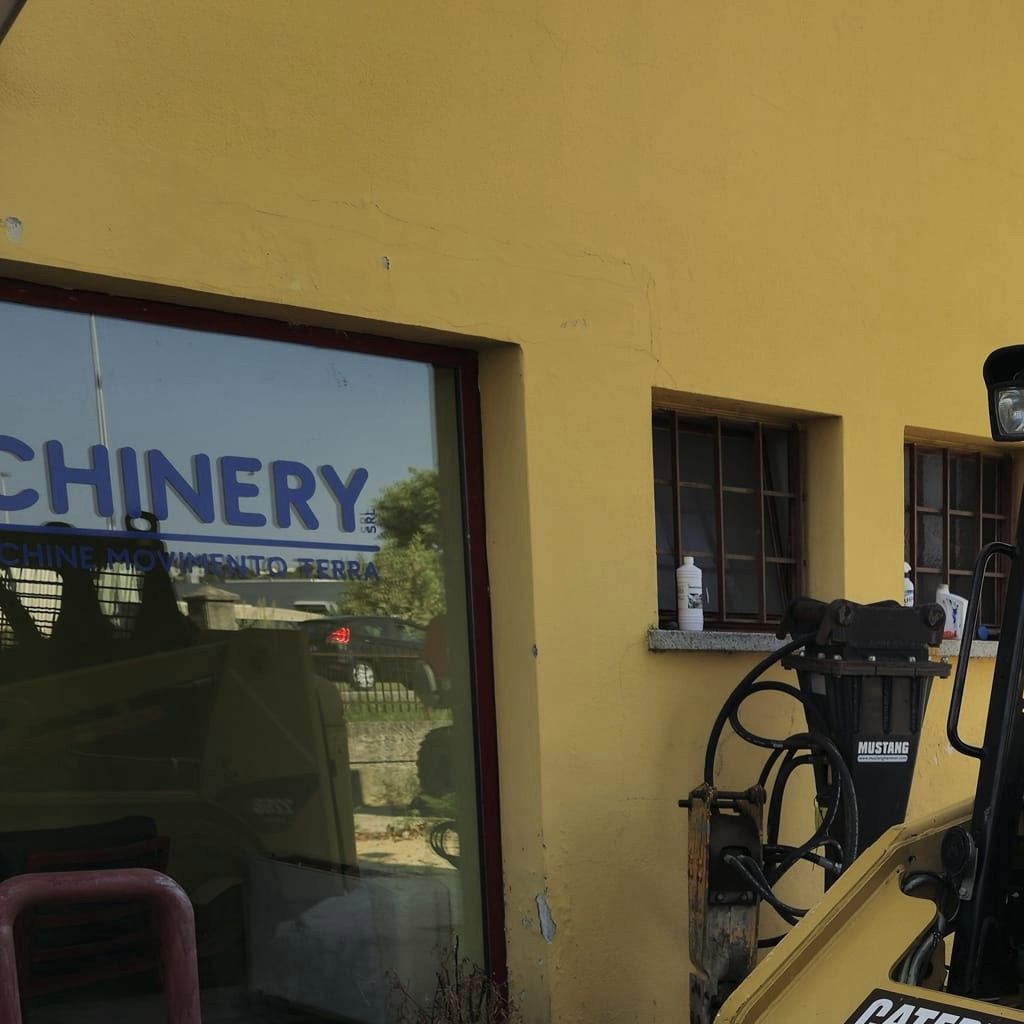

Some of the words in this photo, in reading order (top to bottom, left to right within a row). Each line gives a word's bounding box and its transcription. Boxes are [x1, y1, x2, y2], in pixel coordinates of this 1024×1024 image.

[365, 509, 377, 534] SRL
[106, 545, 288, 577] MOVIMENTO
[297, 558, 380, 582] TERRA
[858, 741, 910, 754] MUSTANG
